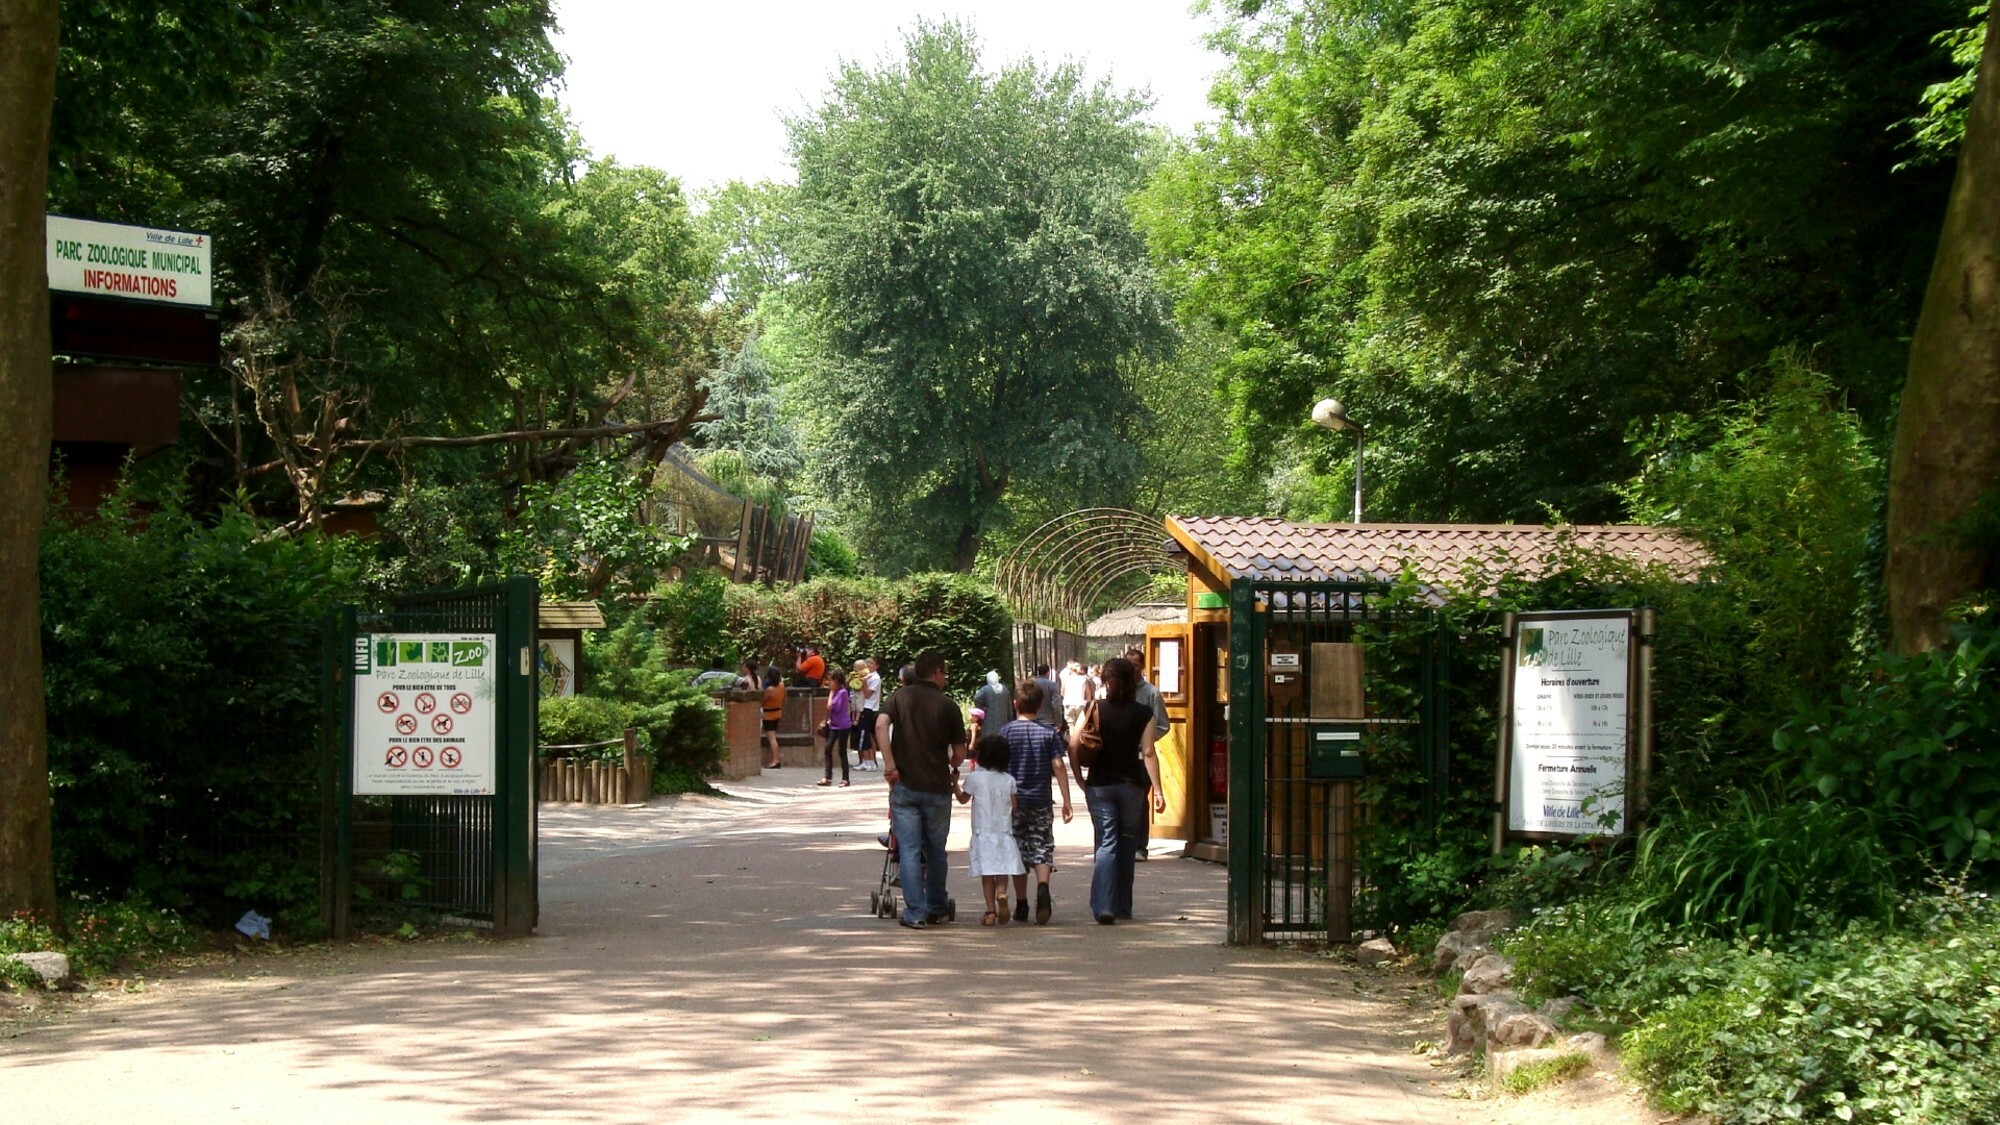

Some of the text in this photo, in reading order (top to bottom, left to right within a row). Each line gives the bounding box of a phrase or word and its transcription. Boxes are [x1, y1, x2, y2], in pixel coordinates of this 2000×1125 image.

[146, 232, 194, 245] Ville de Lille
[56, 239, 202, 275] PARC ZOOLOGIQUE MUNICIPAL
[84, 268, 177, 298] INFORMATIONS
[1548, 624, 1626, 651] Parc Zoologique
[355, 637, 369, 671] INFO
[1548, 647, 1582, 666] de Lille
[375, 668, 486, 683] Parc Zoologique de Lille
[1541, 677, 1600, 686] Horaires d'ouverture
[1538, 764, 1597, 774] Fermeture Annuelle
[1543, 805, 1580, 818] Ville de Lille
